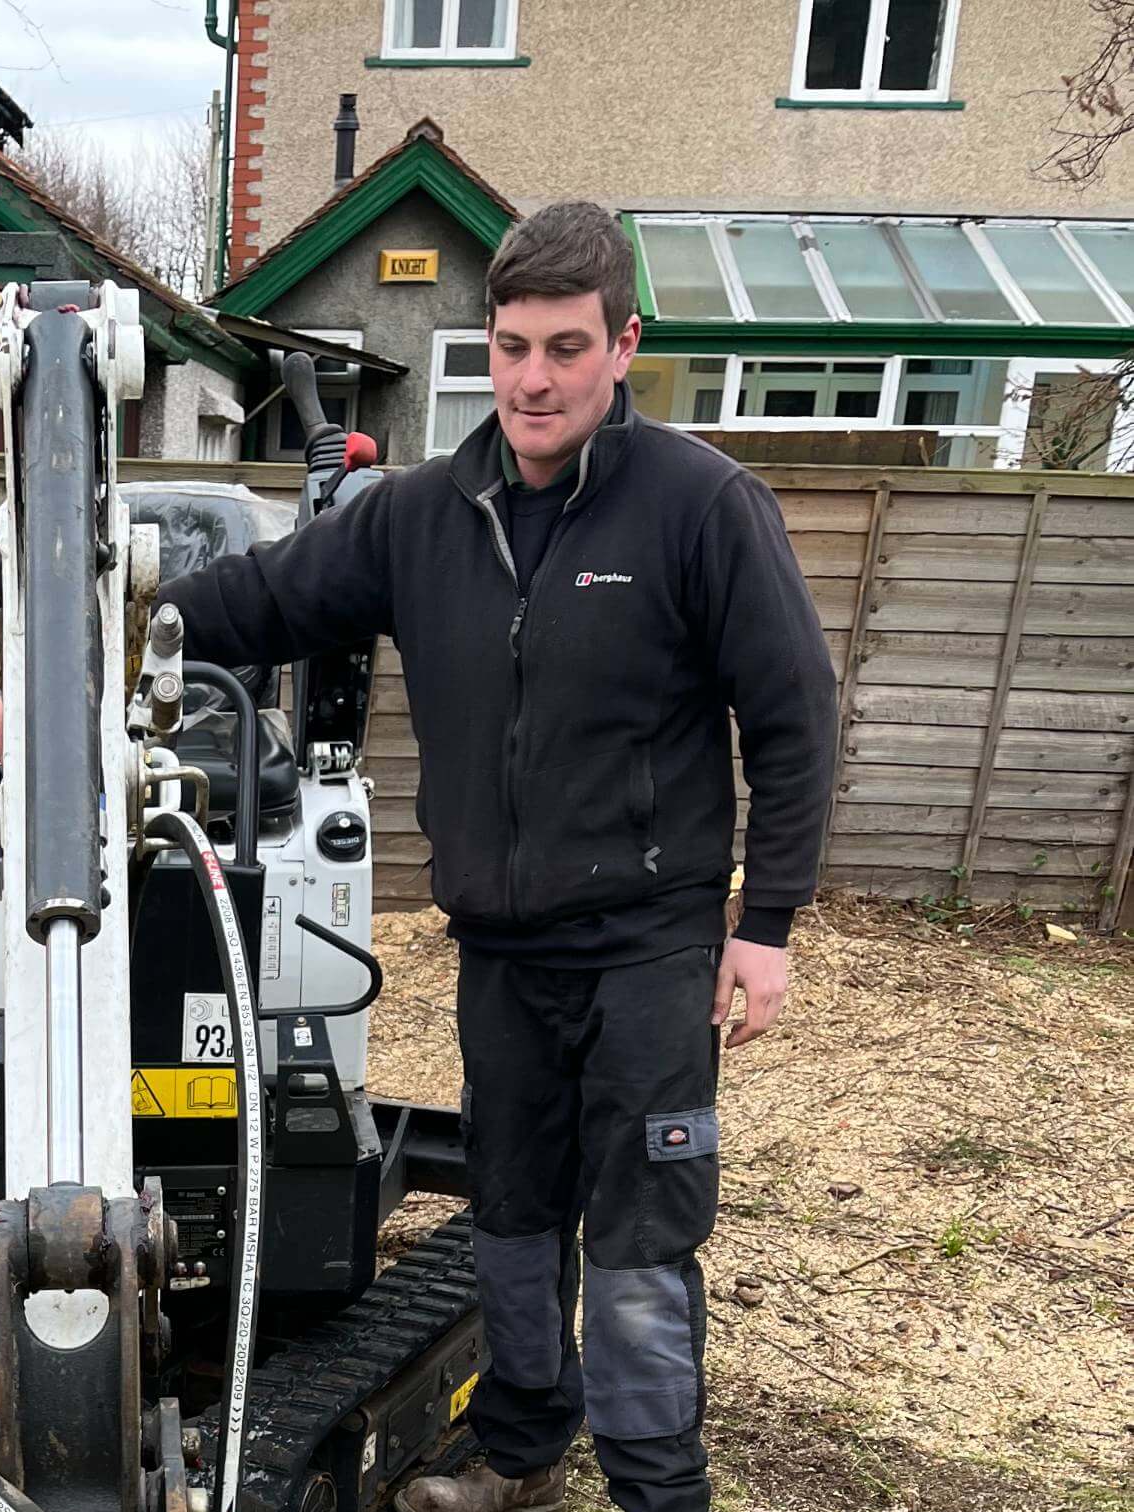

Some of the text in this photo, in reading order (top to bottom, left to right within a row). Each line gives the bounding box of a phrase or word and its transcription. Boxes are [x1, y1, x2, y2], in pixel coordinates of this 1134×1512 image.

[391, 258, 427, 275] KNIGHT
[593, 572, 633, 583] berghaus
[330, 836, 360, 846] DIESEL
[240, 1005, 251, 1027] 853
[195, 1024, 226, 1057] 93
[249, 1119, 259, 1133] 12
[248, 1197, 259, 1227] BAR
[244, 1232, 258, 1273] MSHA
